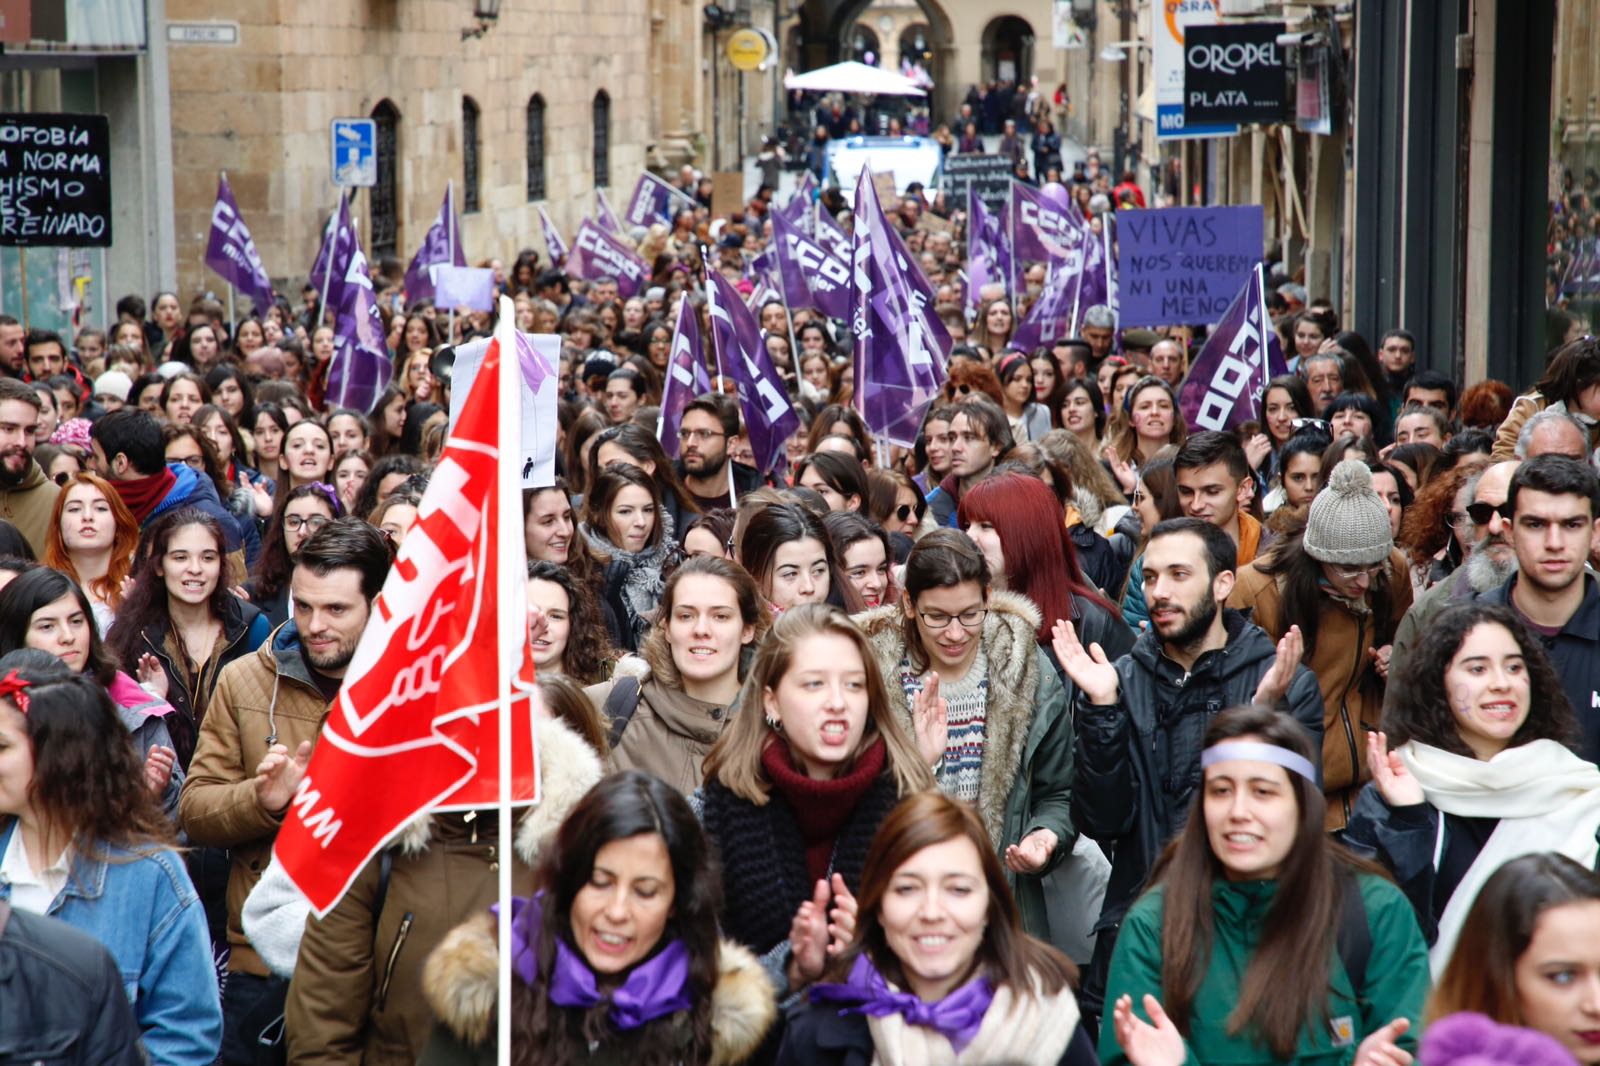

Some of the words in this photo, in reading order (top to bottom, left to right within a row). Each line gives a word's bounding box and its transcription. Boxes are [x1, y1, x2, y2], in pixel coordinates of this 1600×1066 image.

[1167, 0, 1219, 13] OSRA
[1188, 42, 1281, 75] OROPEL
[1190, 90, 1249, 108] PLATA
[23, 150, 100, 174] NORMA
[1127, 214, 1217, 248] VIVAS
[1130, 254, 1172, 274] NOS
[1130, 279, 1152, 296] NI
[1165, 277, 1208, 295] UNA
